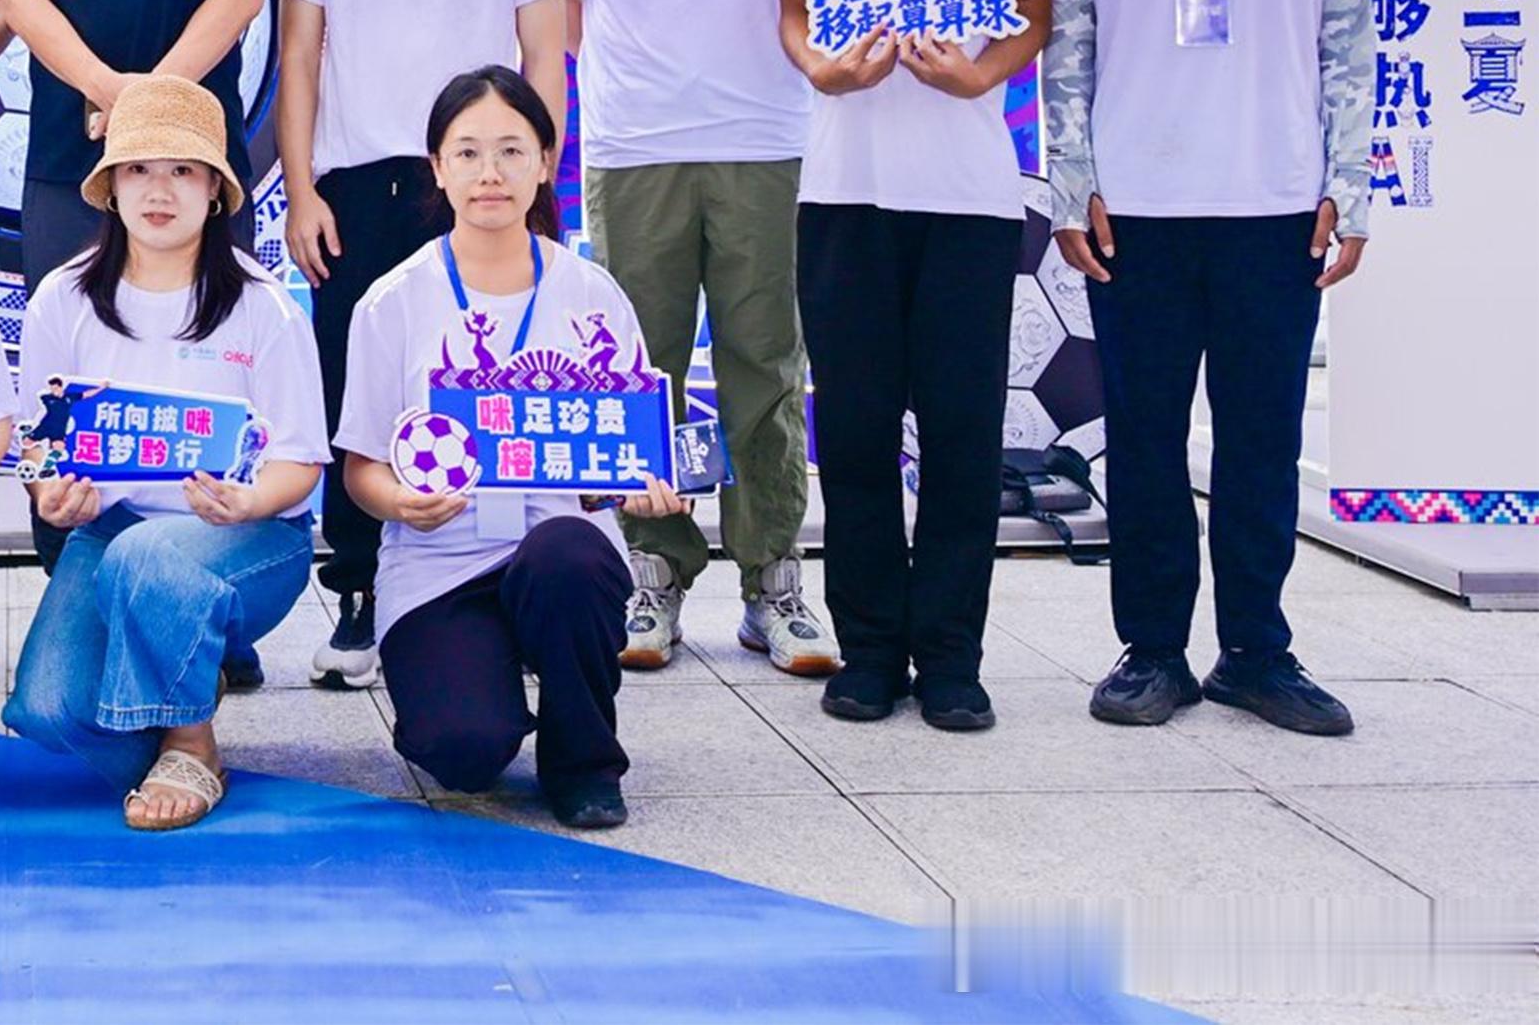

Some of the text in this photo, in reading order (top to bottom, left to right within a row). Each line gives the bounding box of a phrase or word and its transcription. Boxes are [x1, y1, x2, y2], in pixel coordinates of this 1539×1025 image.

[476, 394, 626, 435] 咪足珍贵
[73, 431, 204, 468] 足梦黔行
[497, 438, 650, 483] 榕易上头
